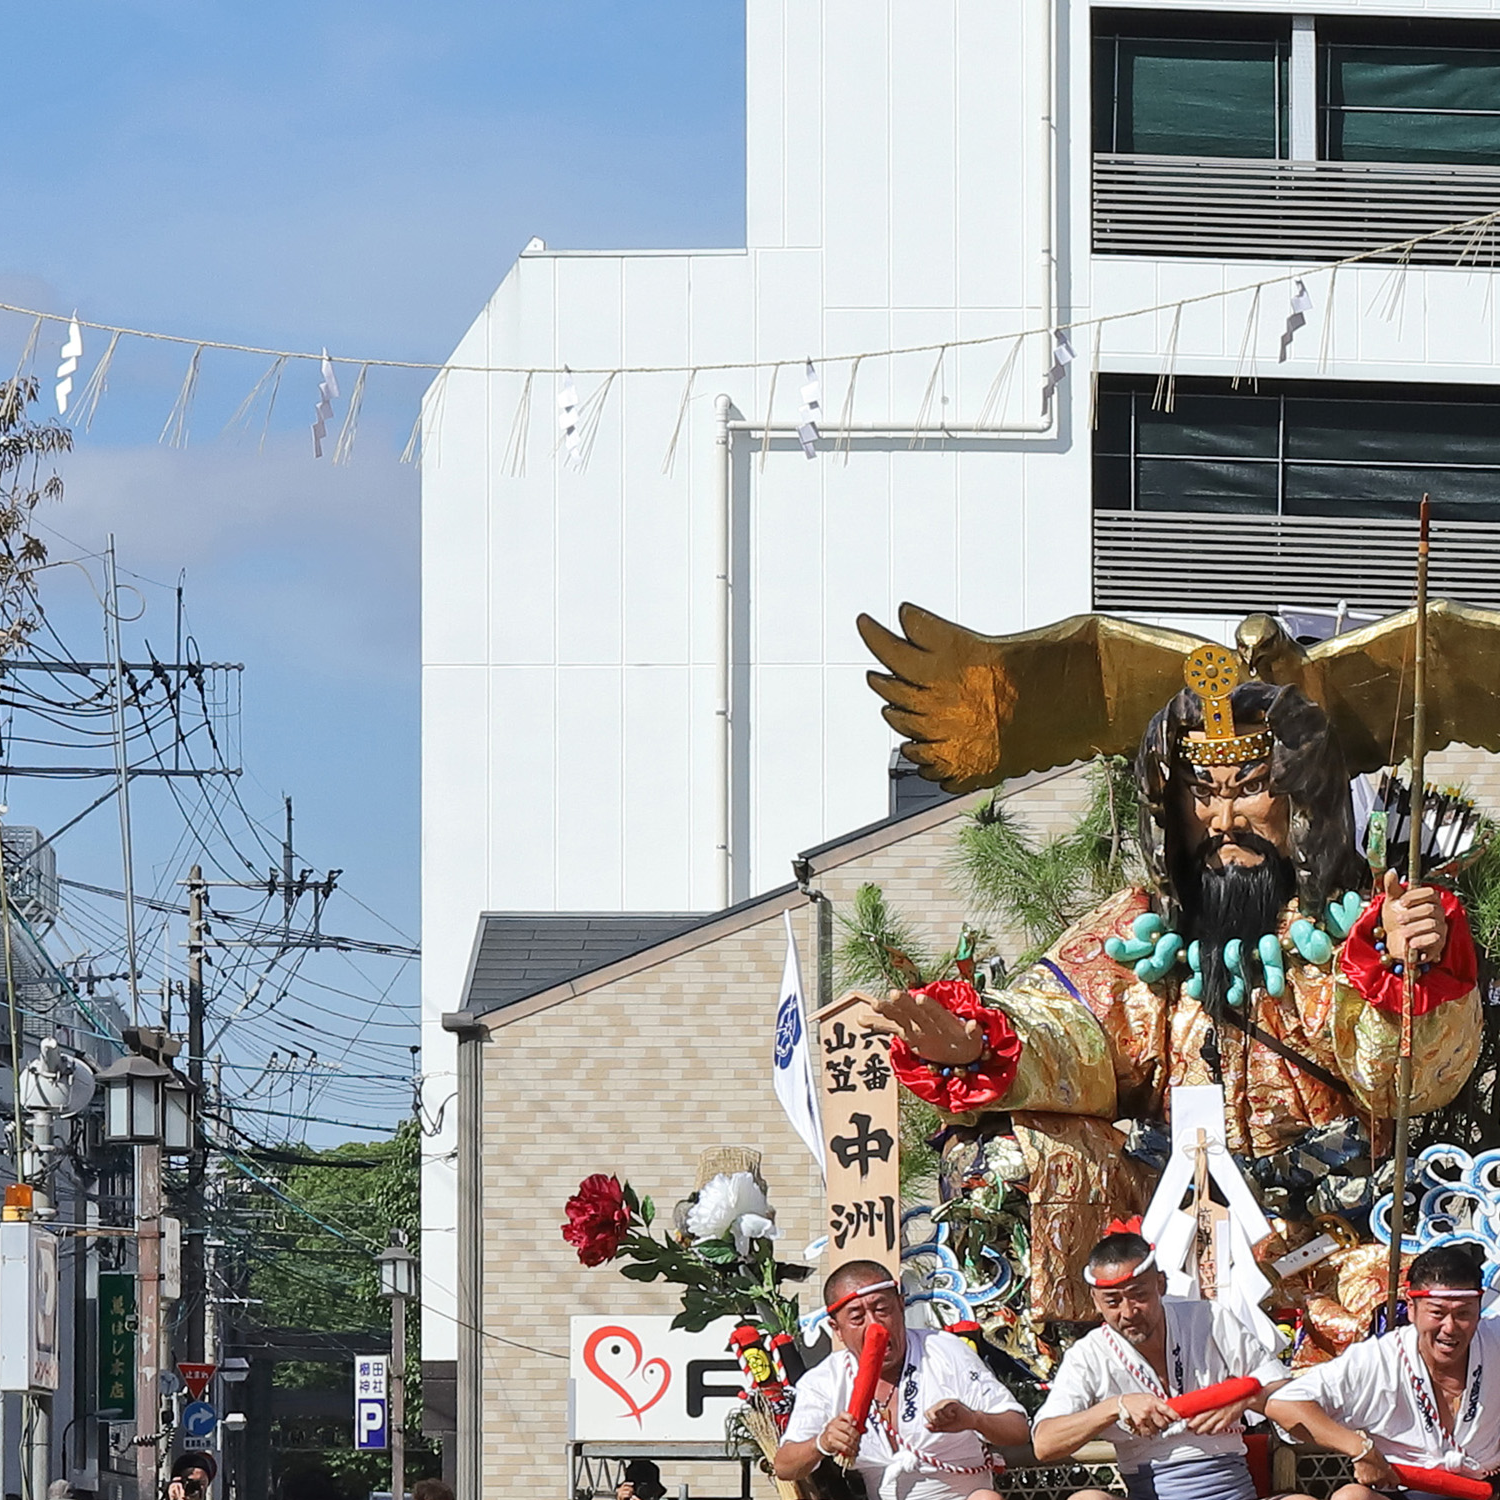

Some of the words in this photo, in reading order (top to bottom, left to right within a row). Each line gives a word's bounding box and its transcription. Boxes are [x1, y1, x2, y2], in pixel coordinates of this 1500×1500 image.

[823, 1021, 859, 1095] 山笠
[829, 1111, 897, 1253] 中洲
[359, 1379, 384, 1394] 神社
[359, 1402, 384, 1444] P
